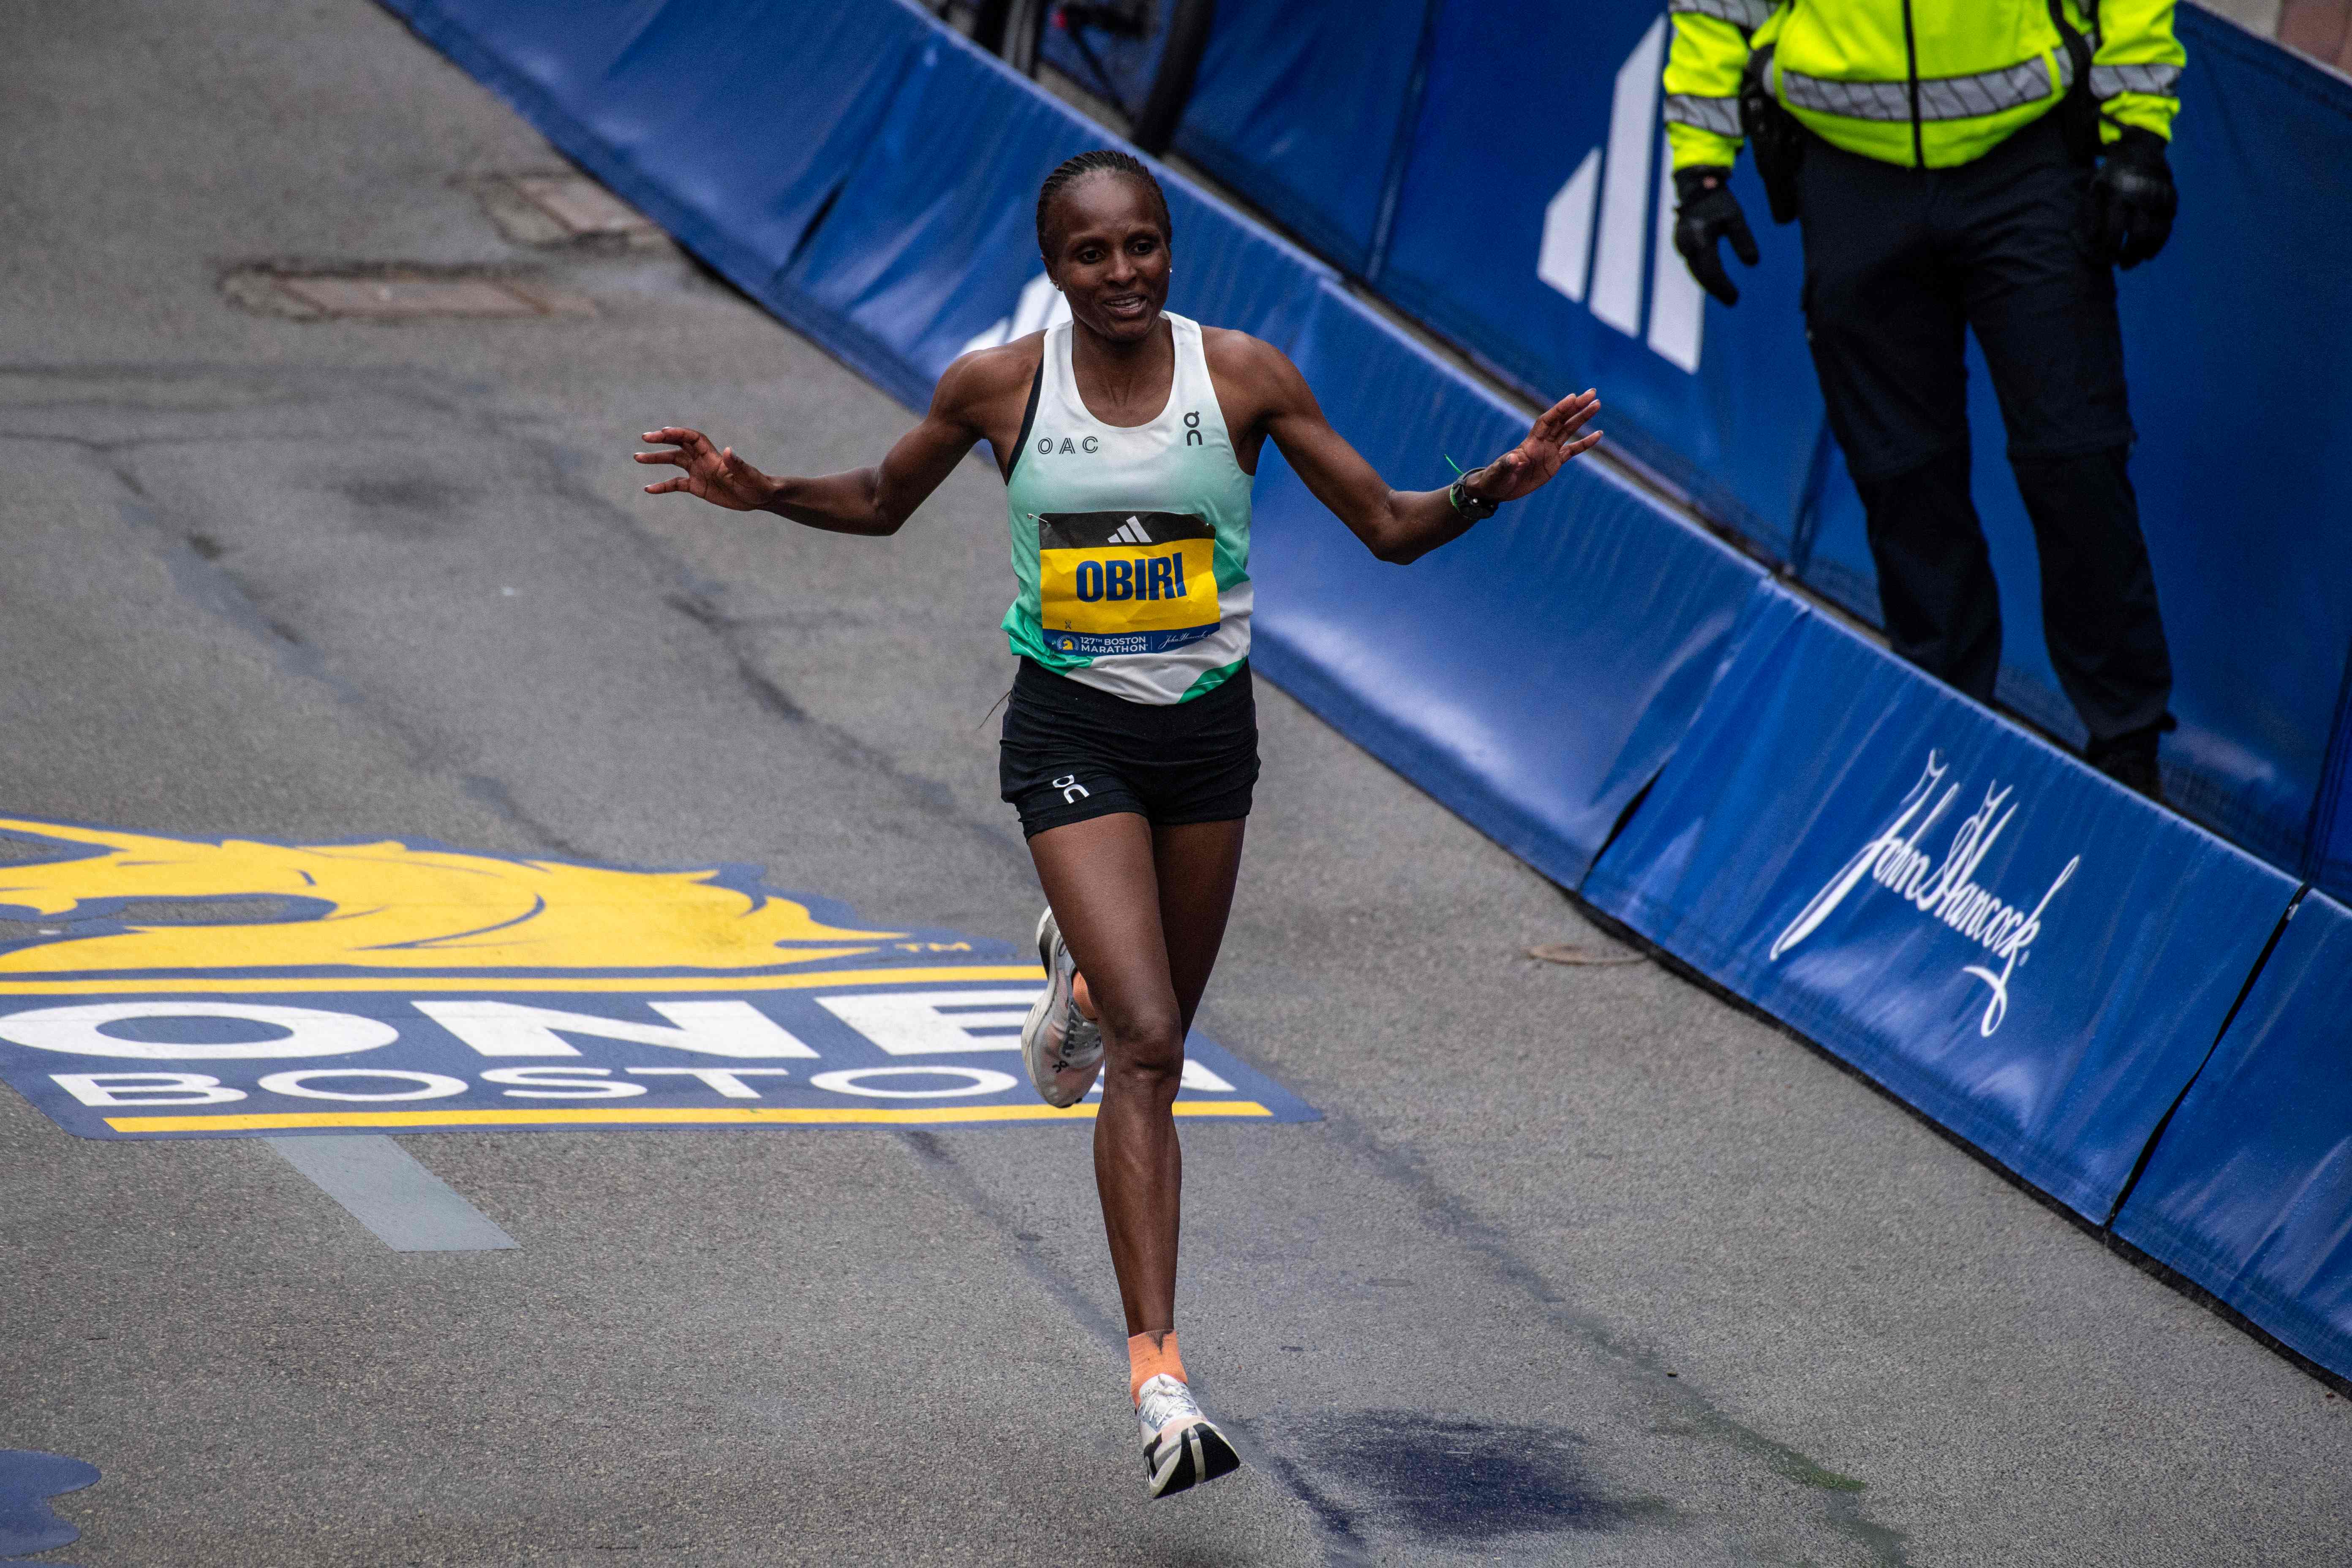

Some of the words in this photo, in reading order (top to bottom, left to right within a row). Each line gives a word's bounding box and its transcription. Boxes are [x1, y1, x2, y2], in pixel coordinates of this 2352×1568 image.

[1037, 436, 1098, 454] OAC
[1076, 552, 1187, 602] OBIRI
[1081, 644, 1146, 653] MARATHON
[1104, 637, 1146, 645] BOSTON
[1770, 748, 1960, 961] John
